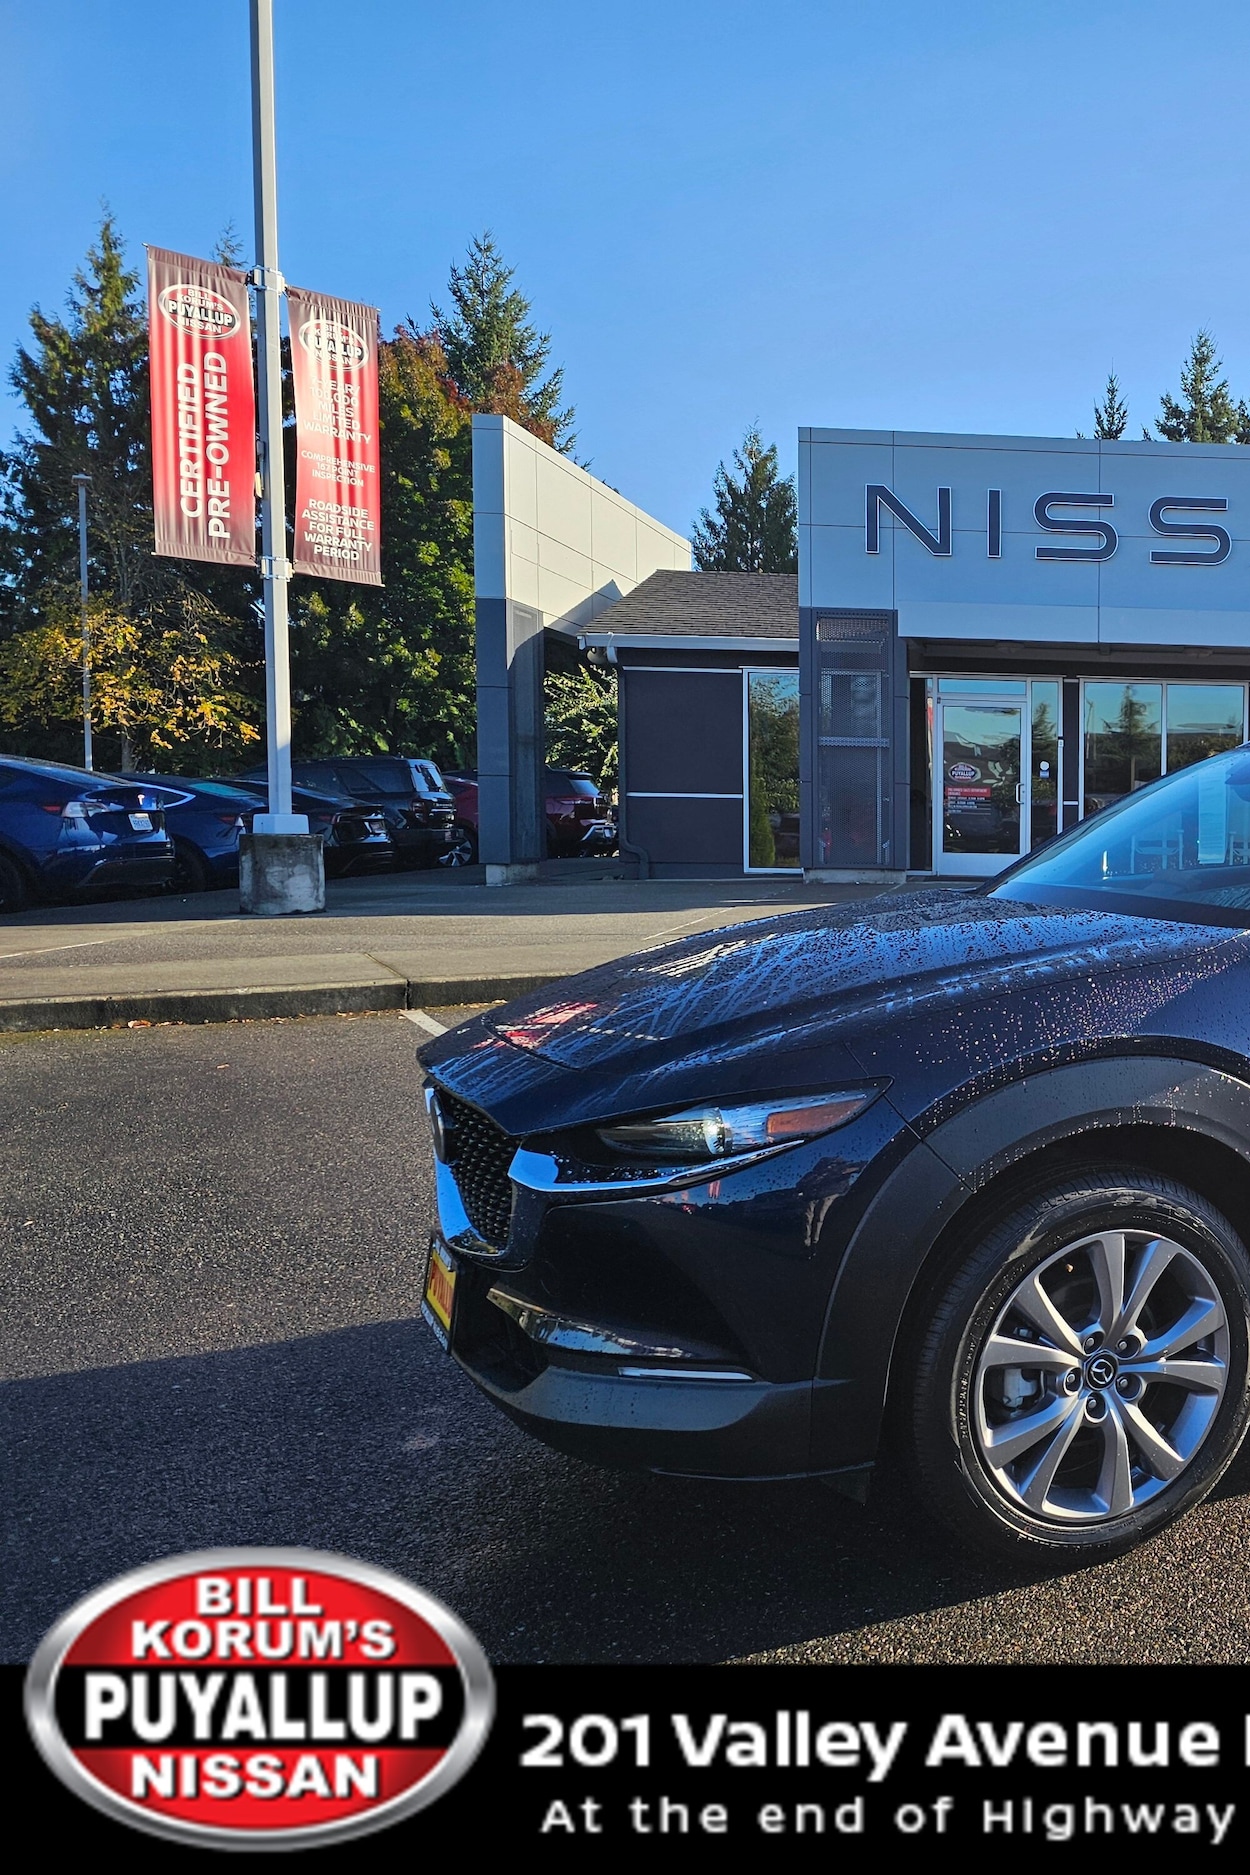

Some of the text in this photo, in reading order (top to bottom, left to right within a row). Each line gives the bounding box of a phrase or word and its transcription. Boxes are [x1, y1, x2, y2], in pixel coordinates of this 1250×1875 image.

[187, 288, 209, 300] BILL
[168, 299, 234, 327] PUYALLUP
[178, 316, 222, 334] NISSAN
[307, 334, 363, 359] PUALUP
[319, 400, 355, 418] MILES
[313, 410, 361, 431] LIMITED
[177, 362, 204, 518] CERTIFIED
[302, 419, 373, 445] WARRANTY
[203, 351, 231, 539] PRE-OWNED
[300, 449, 376, 473] COMPREHENSIVE
[331, 465, 360, 478] POINT
[311, 469, 365, 487] INSPECTION
[308, 498, 369, 519] ROADSIDE
[301, 508, 375, 531] ASSISTANCE
[303, 531, 373, 552] WARRANTY
[308, 521, 366, 541] FOR FULL
[313, 544, 360, 561] PERIOD
